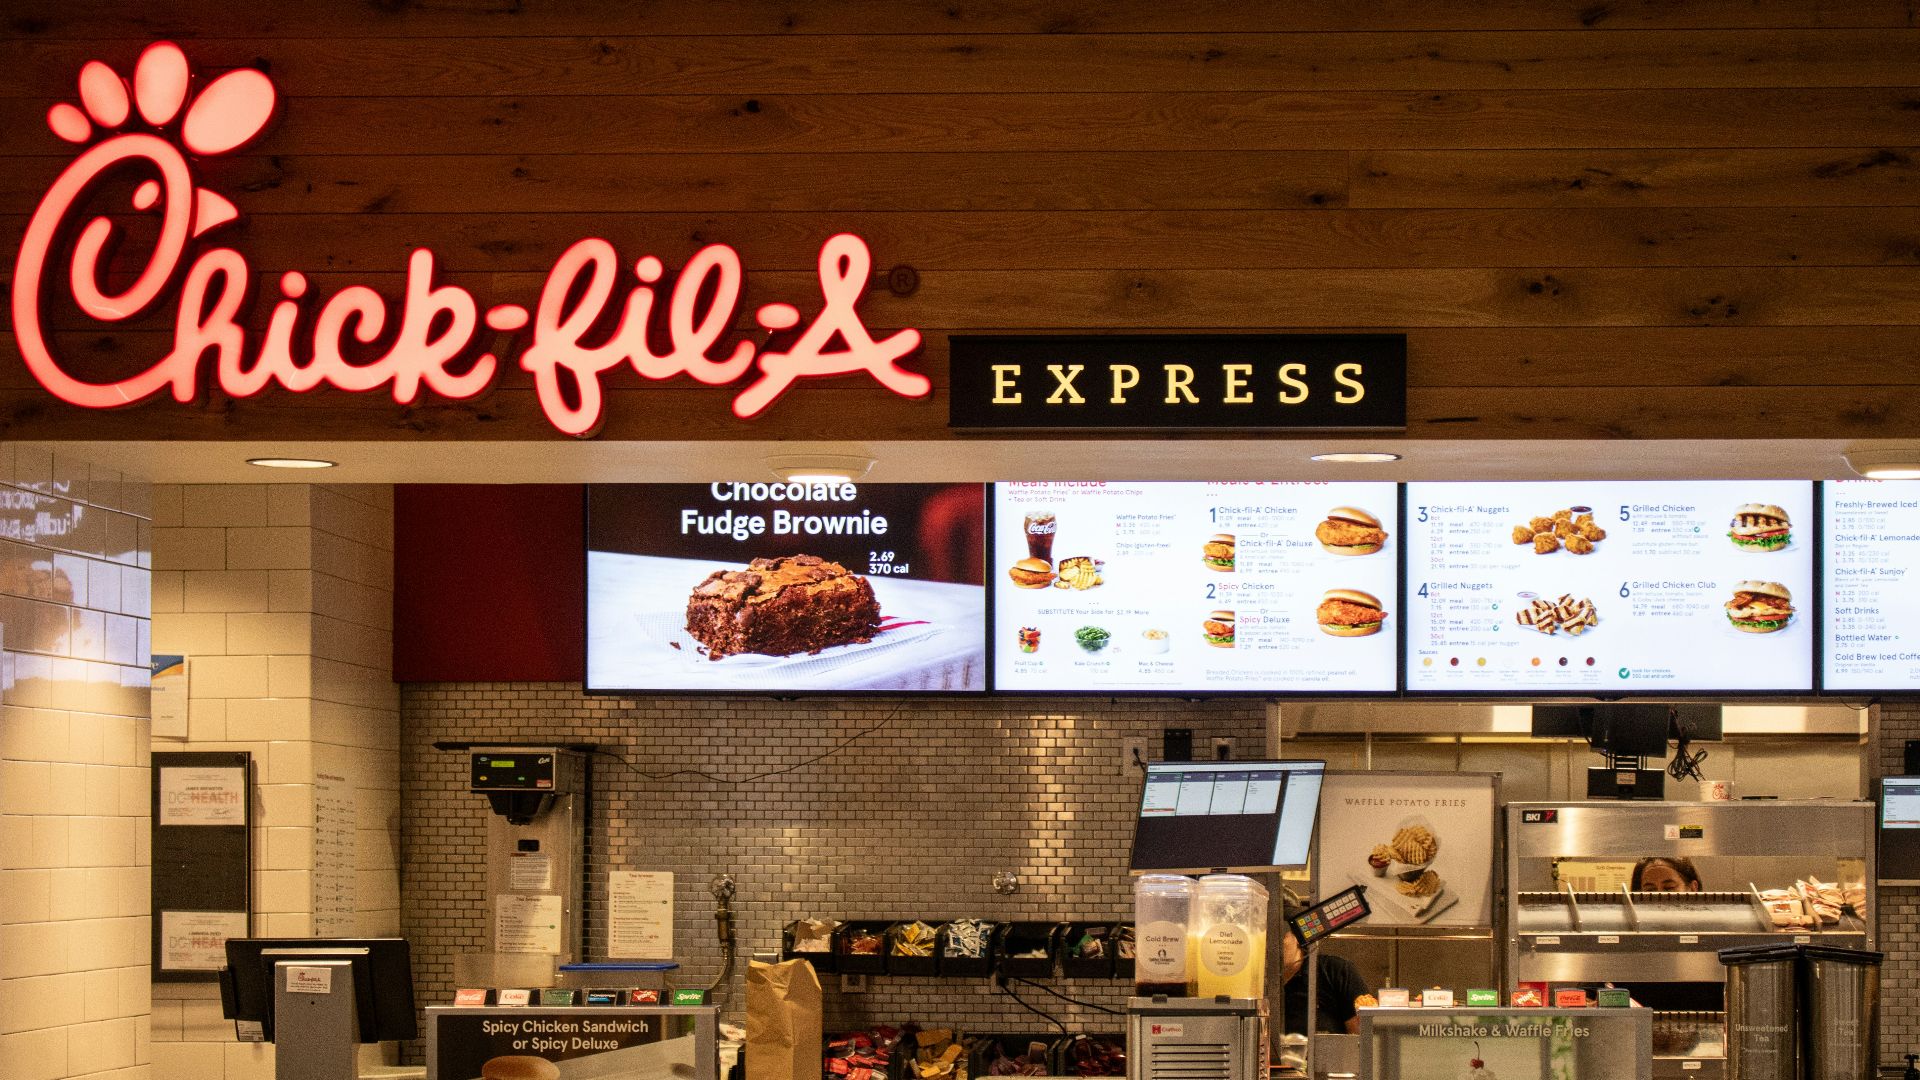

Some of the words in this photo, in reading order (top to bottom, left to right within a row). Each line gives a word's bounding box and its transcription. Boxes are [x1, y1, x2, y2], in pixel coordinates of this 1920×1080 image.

[11, 130, 932, 436] Chick-fil-A
[990, 363, 1366, 404] EXPRESS
[711, 482, 857, 501] Chocolate
[1218, 506, 1261, 514] Chick-fil-A
[1264, 506, 1298, 514] Chicken
[1430, 505, 1473, 513] Chick-fil-A
[1476, 505, 1510, 515] Nuggets
[1632, 504, 1660, 512] Grilled
[1662, 504, 1696, 512] Chicken
[1835, 500, 1898, 510] Freshly-Brewed
[1900, 500, 1918, 508] Iced
[1209, 507, 1216, 523] 1
[1417, 506, 1429, 523] 3
[1619, 505, 1631, 521] 5
[681, 509, 766, 541] Fudge
[773, 509, 888, 535] Brownie
[1835, 534, 1876, 542] Chick-fil-A
[869, 551, 895, 562] 2.69
[868, 563, 891, 574] 370
[893, 563, 909, 574] cal
[1879, 568, 1906, 576] Sunjoy
[1218, 583, 1240, 592] Spicy
[1460, 582, 1493, 590] Nuggets
[1619, 581, 1631, 598] 6
[1632, 581, 1660, 589] Grilled
[1662, 581, 1696, 589] Chicken
[1697, 581, 1717, 589] Club
[1206, 583, 1216, 599] 2
[1417, 583, 1429, 598] 4
[1835, 607, 1852, 615] Soft
[1854, 607, 1879, 615] Drinks
[1240, 615, 1261, 624] Spicy
[1263, 615, 1290, 623] Deluxe
[1835, 634, 1866, 642] Bottled
[1867, 634, 1892, 642] Water
[1835, 653, 1854, 661] Cold
[1856, 653, 1878, 661] Brew
[1879, 653, 1897, 661] Iced
[1345, 798, 1385, 806] WAFFLE
[1390, 799, 1430, 807] POTATO
[1435, 800, 1466, 808] FRIES
[1525, 813, 1541, 821] BKI
[191, 936, 225, 949] HEAL
[1145, 935, 1161, 943] Cold
[1163, 935, 1180, 943] Brew
[677, 993, 702, 1001] Sprite
[1470, 993, 1495, 1001] Sprite
[482, 1019, 519, 1036] Spicy
[522, 1019, 579, 1034] Chicken
[582, 1019, 649, 1034] Sandwich
[1419, 1023, 1487, 1037] Milkshake
[1491, 1024, 1502, 1037] &
[1506, 1023, 1552, 1037] Waffle
[1555, 1024, 1590, 1037] Fries
[1735, 1023, 1788, 1033] Unsweetened
[1754, 1034, 1770, 1042] Tea
[512, 1039, 529, 1050] or
[531, 1036, 568, 1053] Spicy
[571, 1036, 619, 1050] Deluxe
